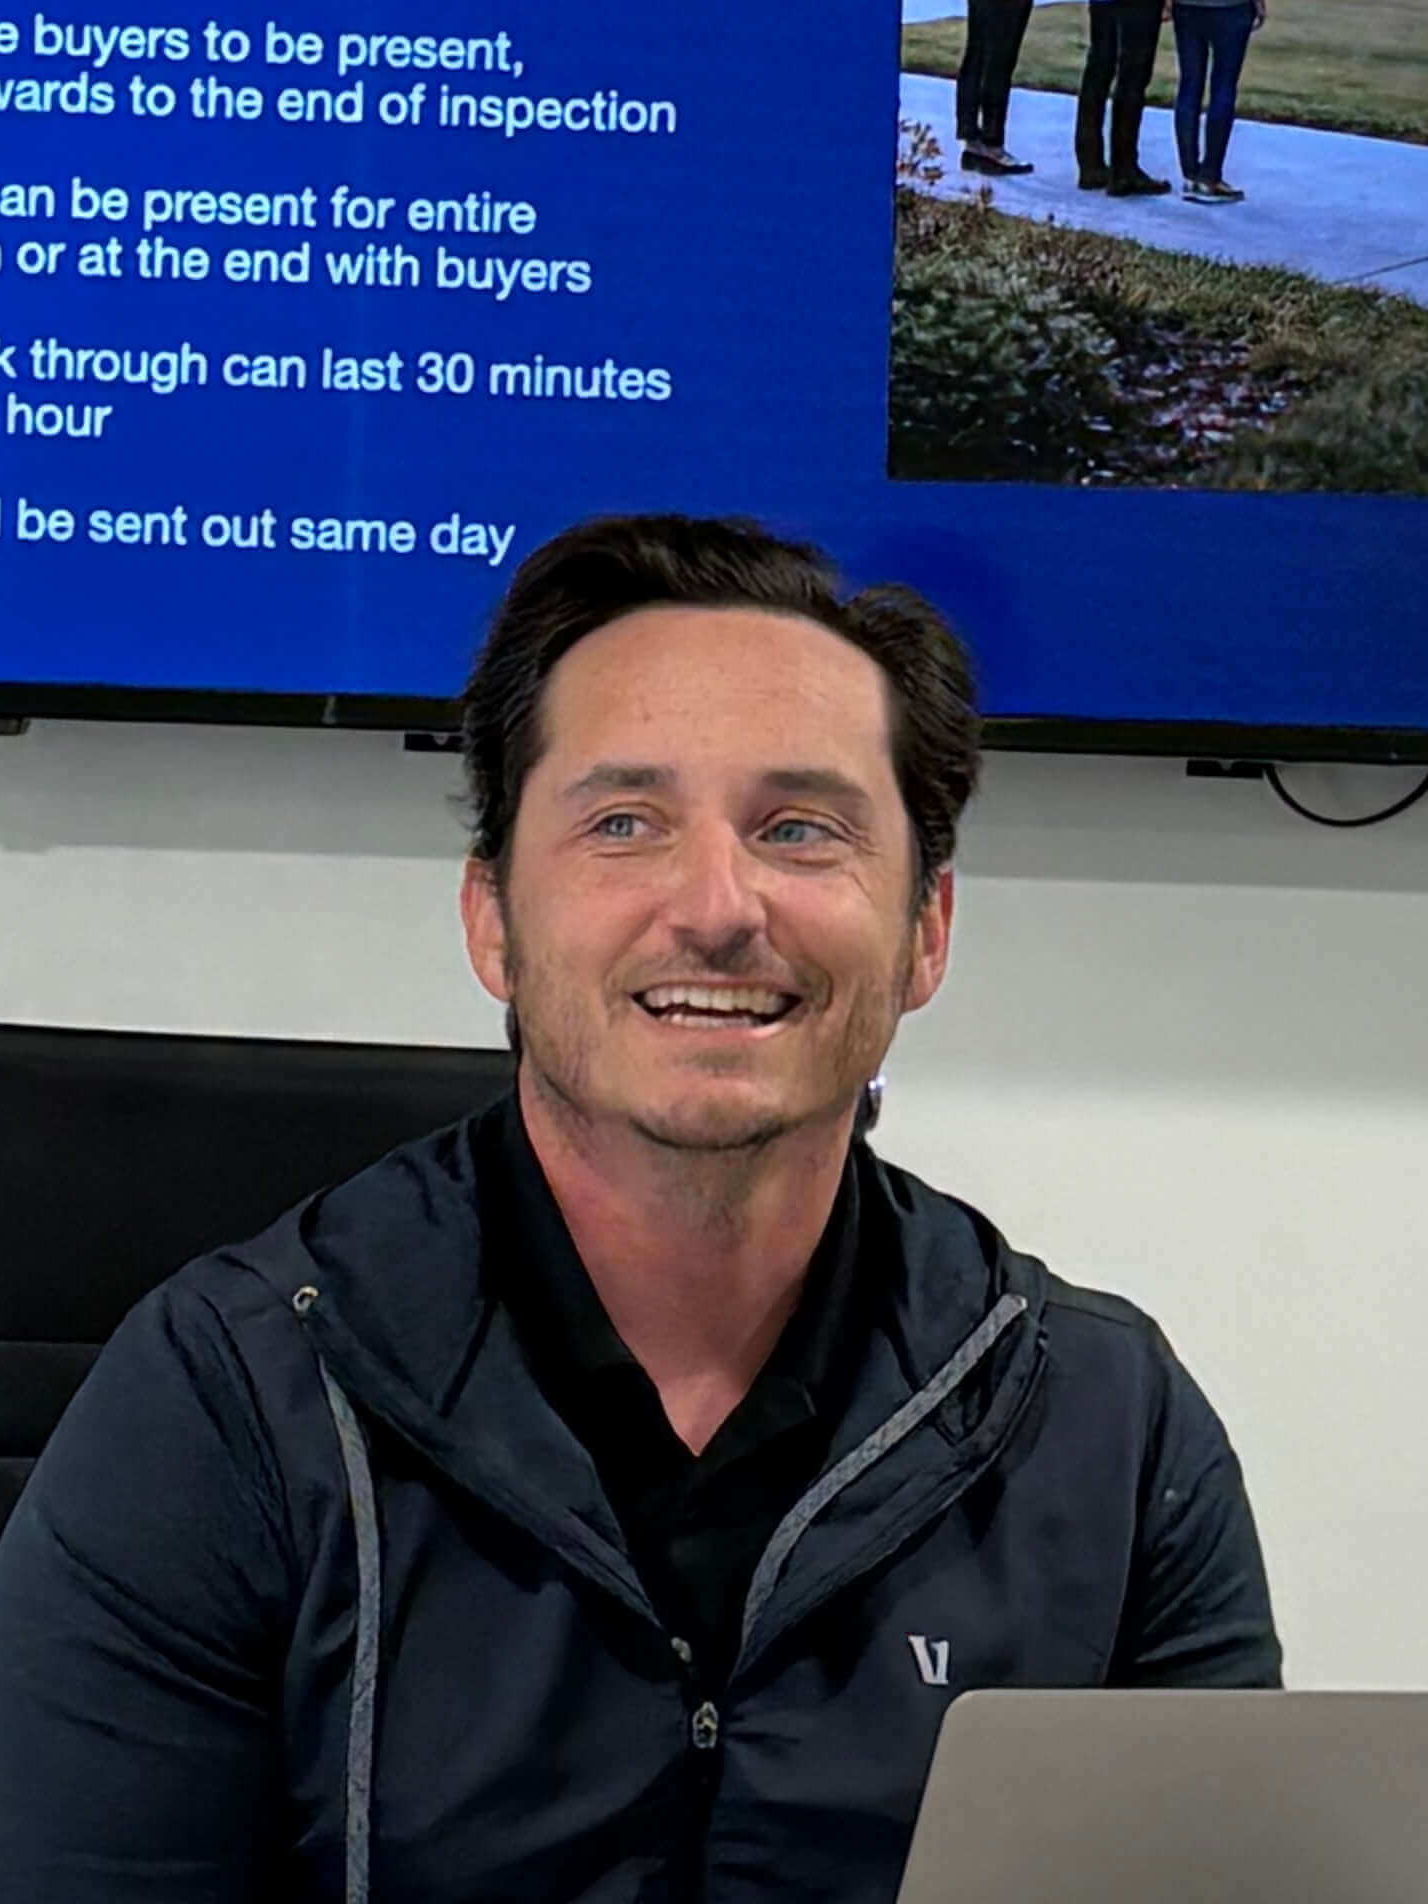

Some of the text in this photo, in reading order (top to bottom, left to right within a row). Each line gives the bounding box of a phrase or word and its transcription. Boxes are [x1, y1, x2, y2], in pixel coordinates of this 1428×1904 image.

[34, 13, 190, 67] buyers
[203, 21, 250, 62] to
[266, 21, 324, 64] be
[338, 32, 523, 77] present,
[129, 75, 176, 116] to
[190, 76, 263, 119] the
[277, 80, 364, 122] end
[379, 83, 426, 124] of
[440, 84, 676, 137] inspection
[71, 176, 129, 220] be
[144, 187, 317, 232] present
[330, 185, 395, 229] for
[408, 191, 536, 234] entire
[17, 242, 66, 274] or
[78, 237, 123, 277] at
[136, 236, 210, 280] the
[224, 242, 310, 282] end
[325, 243, 420, 286] with
[437, 246, 591, 300] buyers
[29, 338, 207, 394] through
[223, 354, 306, 388] can
[322, 348, 404, 391] last
[417, 352, 474, 393] 30
[490, 355, 671, 400] minutes
[7, 392, 113, 437] hour
[17, 498, 75, 541] be
[89, 506, 188, 545] sent
[202, 509, 277, 548] out
[290, 518, 416, 553] same
[430, 513, 516, 566] day
